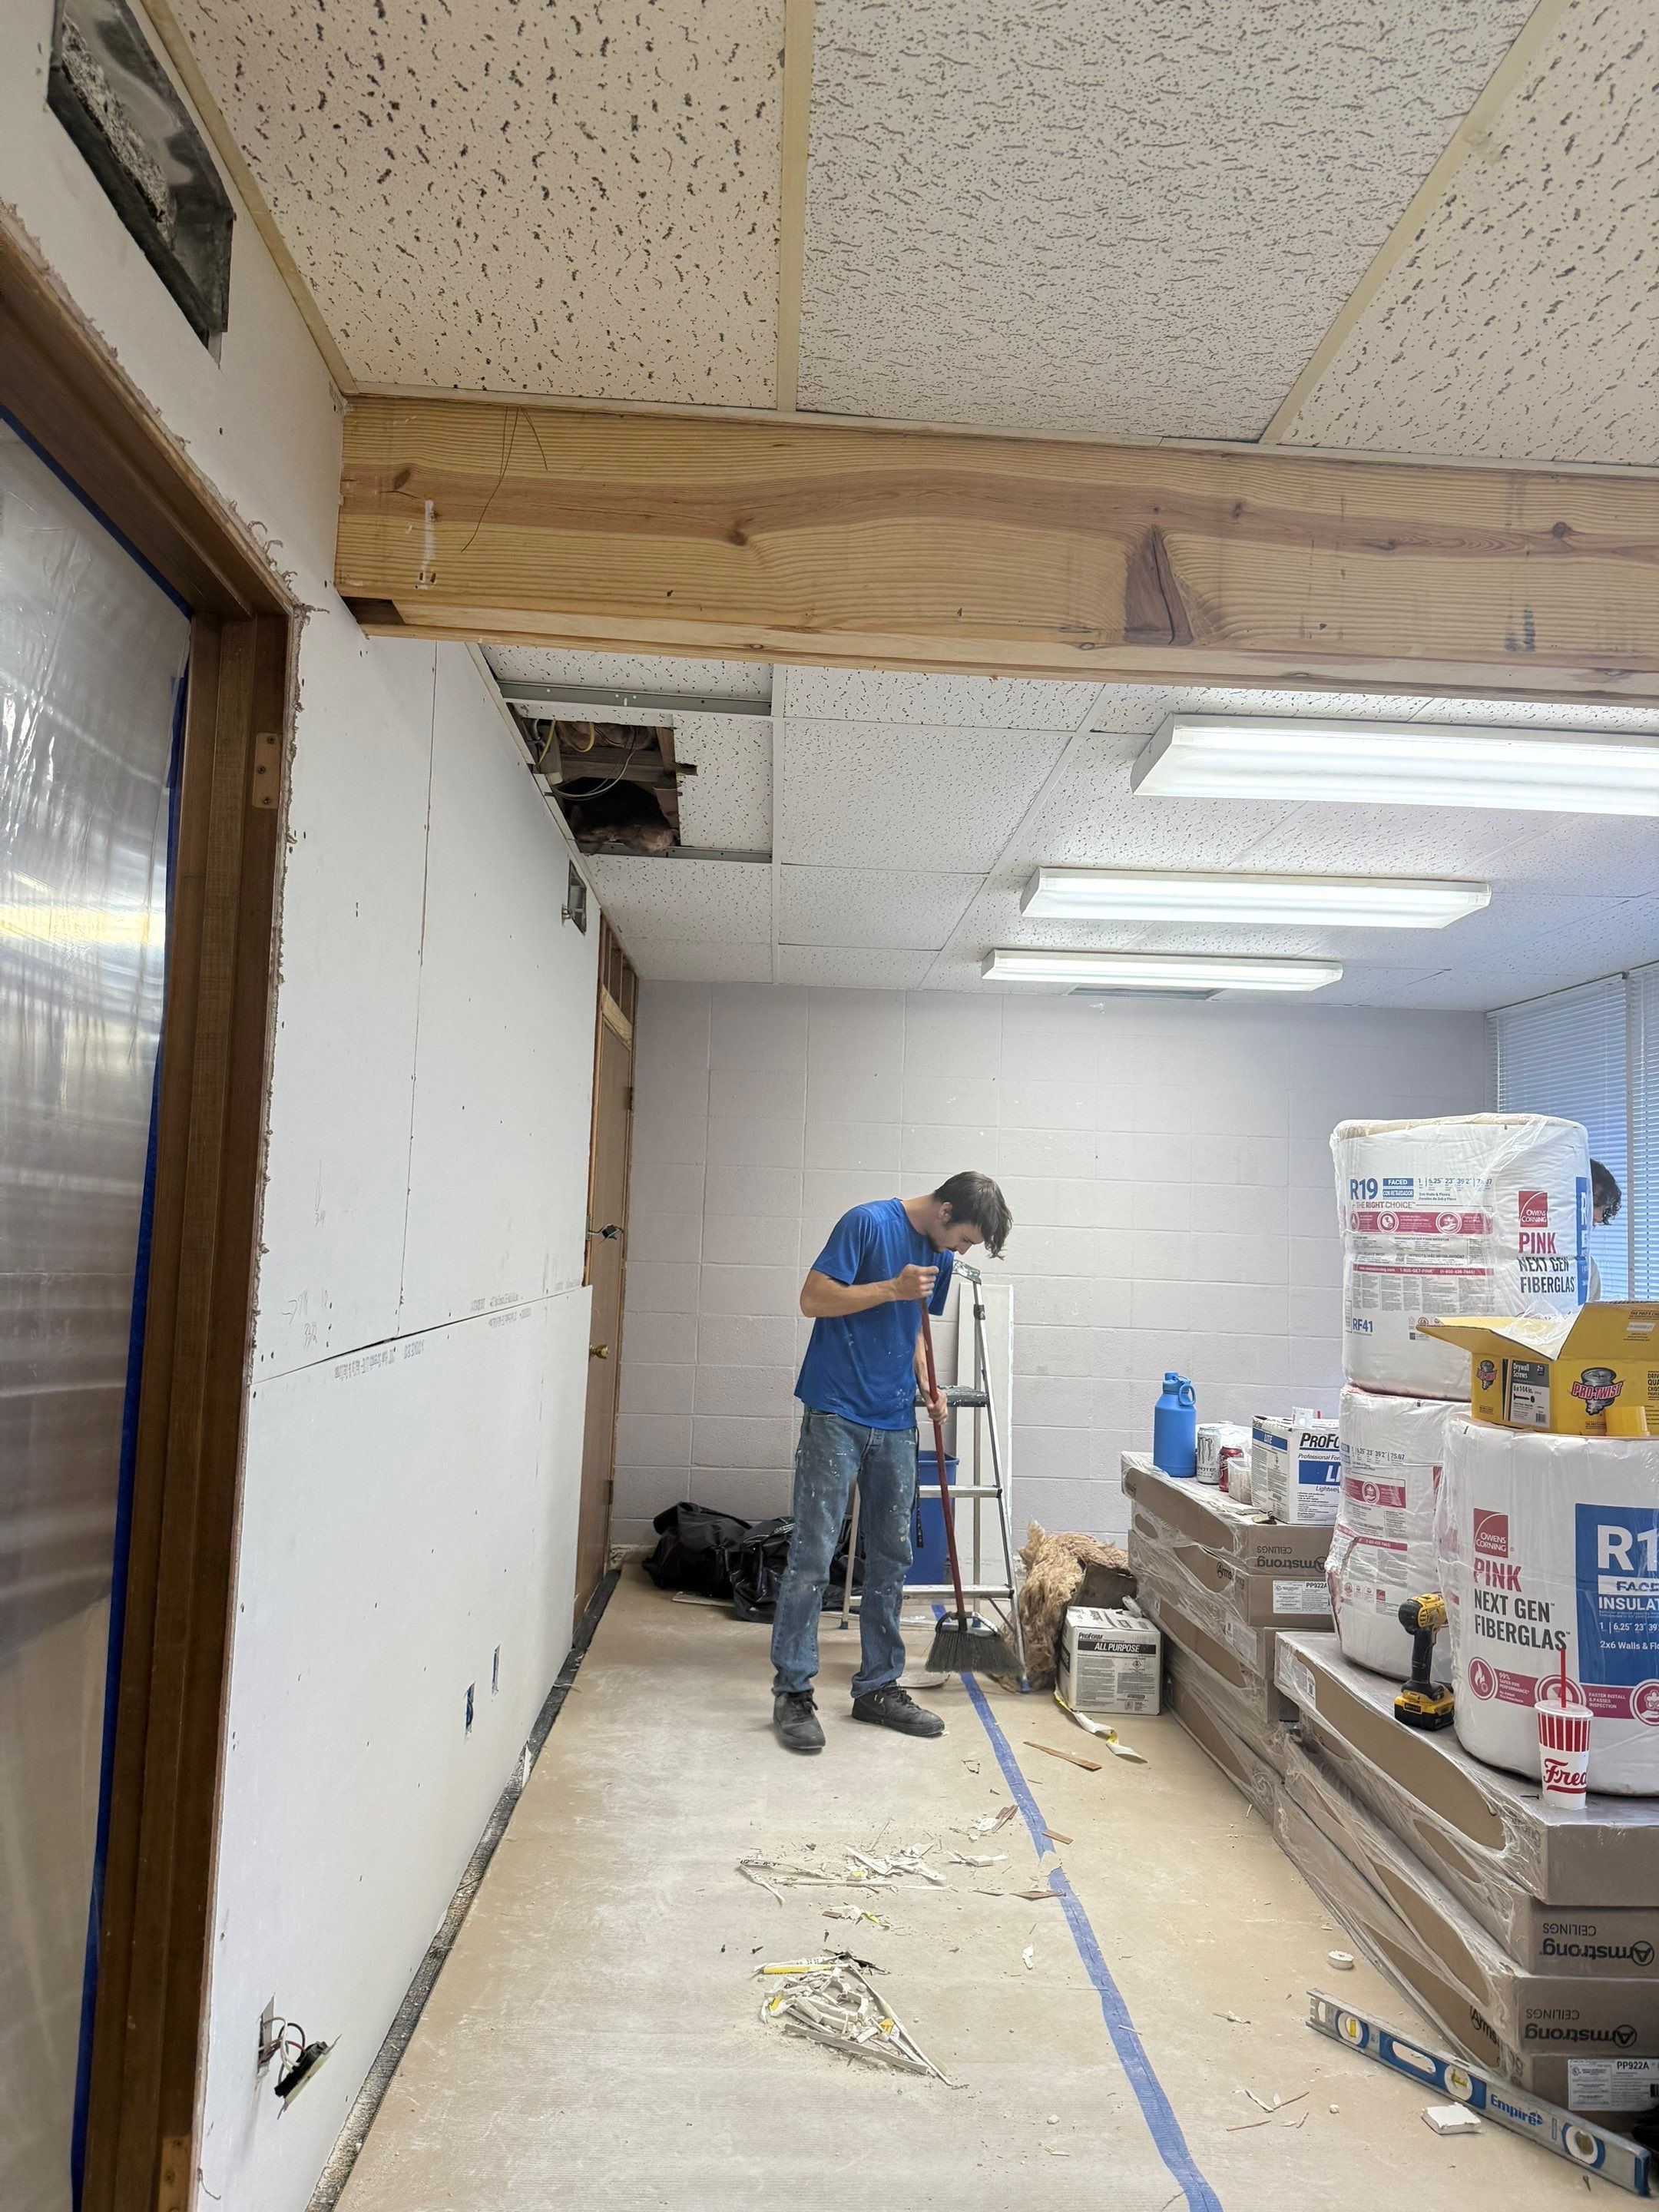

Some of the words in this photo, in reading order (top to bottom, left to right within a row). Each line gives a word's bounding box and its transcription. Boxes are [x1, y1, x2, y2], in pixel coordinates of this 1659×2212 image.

[1349, 1177, 1379, 1200] R19
[1518, 1232, 1557, 1254] PINK
[1518, 1257, 1548, 1272] NEXT
[1353, 1318, 1373, 1333] RF41
[1513, 1363, 1530, 1372] Drywall
[1572, 1382, 1623, 1400] PRO-TWIST
[1475, 1538, 1507, 1552] CORNING
[1480, 1532, 1506, 1544] OWENS
[1257, 1545, 1293, 1555] CEILINGS
[1474, 1557, 1522, 1592] PINK
[1475, 1588, 1508, 1615] NEXT
[1094, 1642, 1108, 1651] ALL
[1108, 1644, 1140, 1653] PURPOSE
[1618, 1641, 1641, 1650] Walls
[1542, 1922, 1597, 1936] CEILINGS
[1541, 1938, 1655, 1967] Armstrong
[1525, 2008, 1580, 2020] CEILINGS
[1525, 2023, 1637, 2048] Armstrong
[1617, 2061, 1650, 2070] PP922A
[1491, 2094, 1537, 2126] Empire
